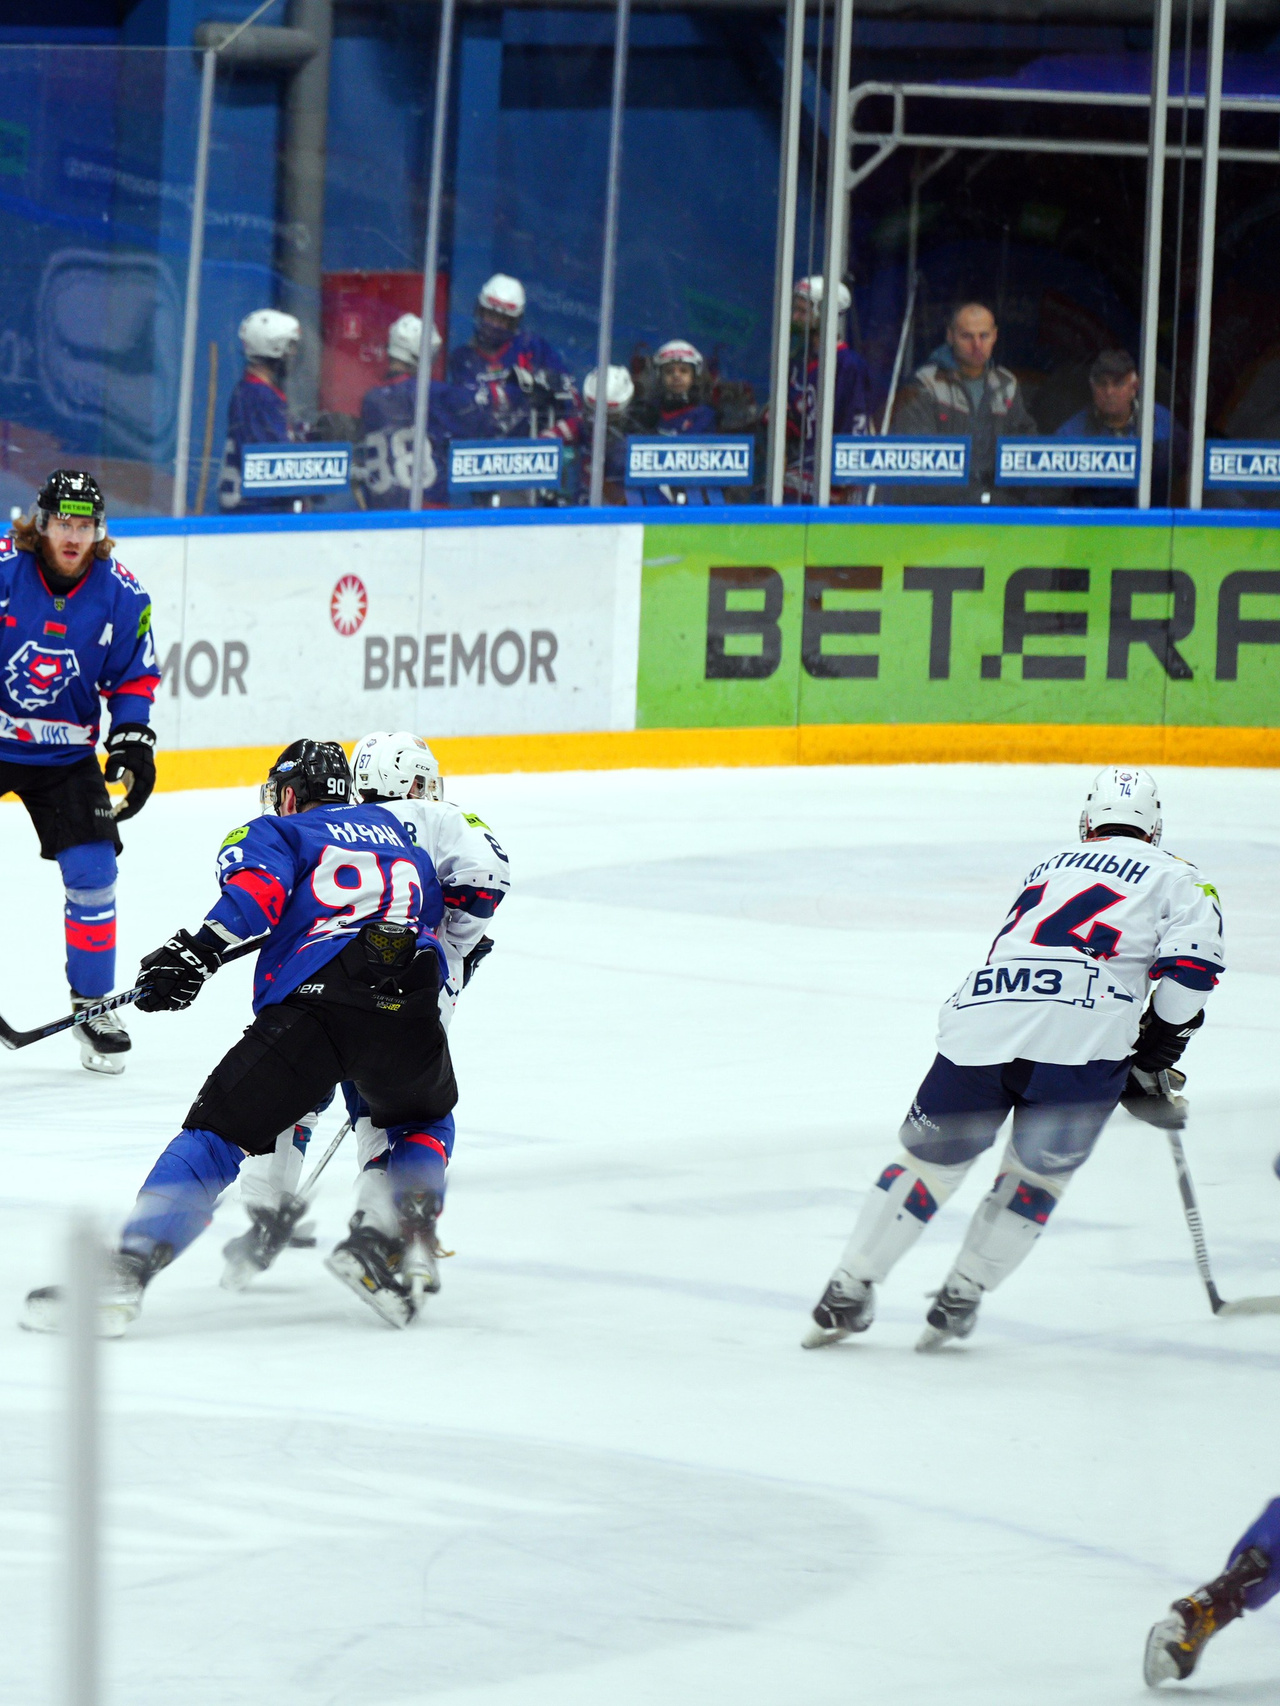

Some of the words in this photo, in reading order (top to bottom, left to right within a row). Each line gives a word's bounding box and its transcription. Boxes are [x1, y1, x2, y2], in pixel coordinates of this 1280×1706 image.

[244, 457, 349, 480] BELARUSKALI
[452, 453, 559, 475] BELARUSKALI
[630, 450, 749, 470] BELARUSKALI
[835, 450, 965, 470] BELARUSKALI
[1001, 452, 1137, 473] BELARUSKALI
[1209, 454, 1280, 476] BELAR
[156, 639, 250, 698] MOR
[363, 630, 558, 691] BREMOR
[359, 754, 372, 769] 87
[415, 763, 431, 772] CCM
[326, 777, 346, 796] 90
[1119, 783, 1132, 798] 74
[311, 845, 424, 936] 90
[986, 879, 1128, 966] 74
[164, 939, 213, 981] CCM
[972, 967, 1064, 997] БМЗ
[74, 988, 144, 1026] SOYUZ
